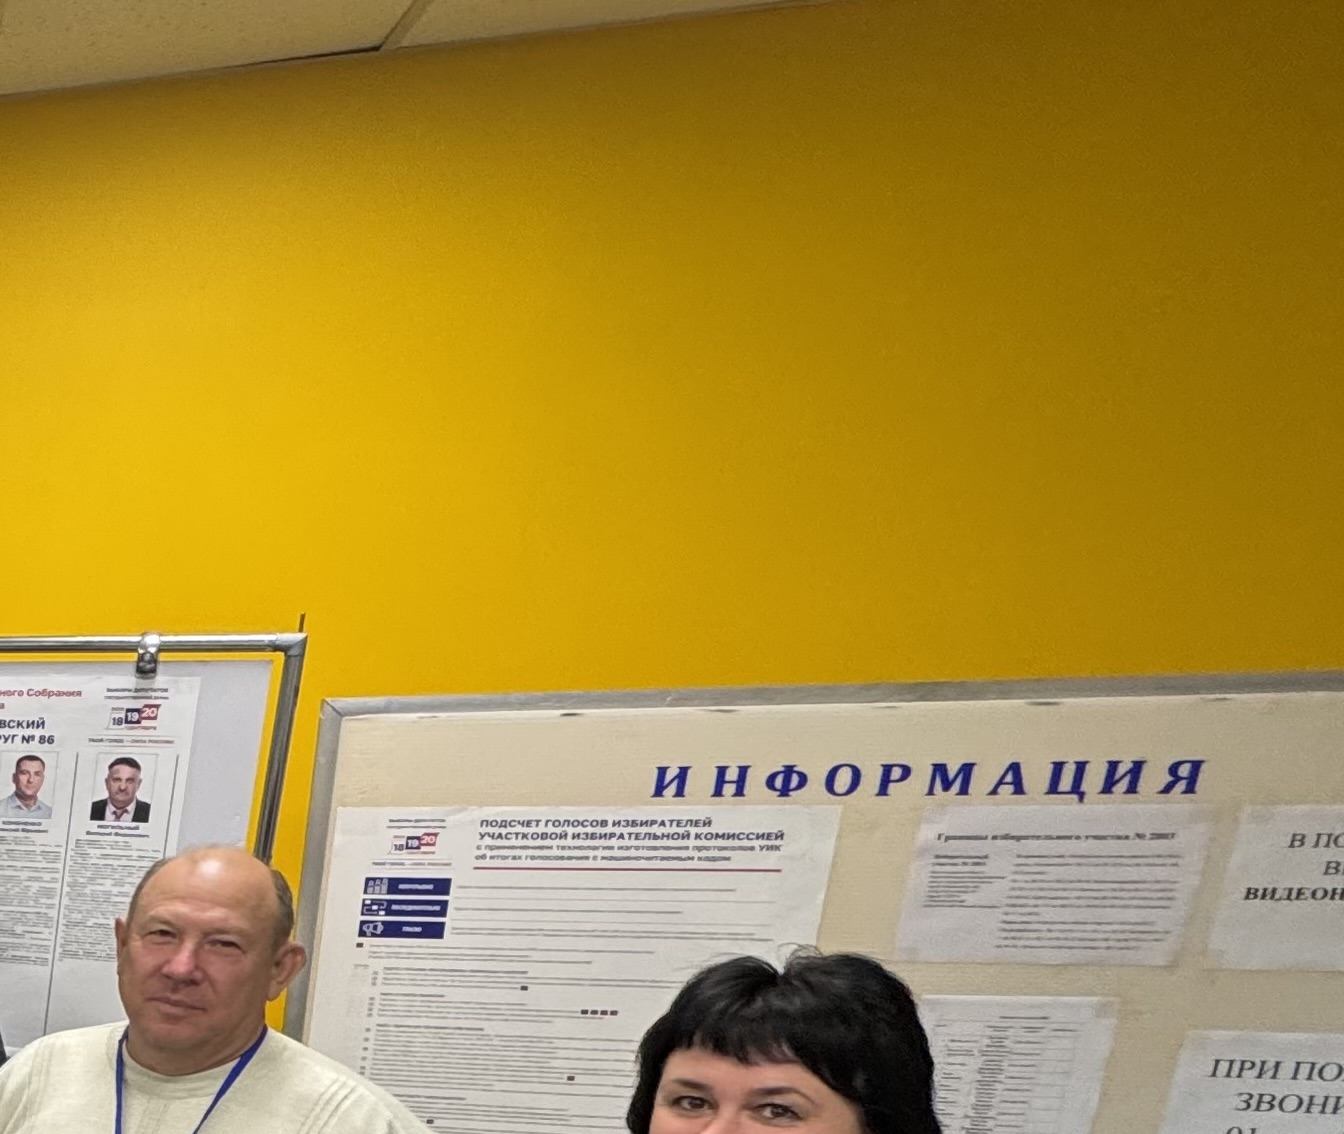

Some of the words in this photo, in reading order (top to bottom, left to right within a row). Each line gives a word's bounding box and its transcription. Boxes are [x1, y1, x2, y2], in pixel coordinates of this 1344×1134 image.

[26, 689, 82, 699] Собрания
[127, 711, 139, 721] 19
[141, 708, 157, 718] 20
[21, 734, 35, 744] №
[38, 735, 55, 744] 86
[650, 760, 1206, 803] ИНФОРМАЦИЯ
[480, 819, 542, 829] ПОДСЧЕТ
[544, 819, 609, 828] ГОЛОСОВ
[612, 816, 713, 828] ИЗБИРАТЕЛЕЙ
[407, 838, 419, 847] 19
[420, 833, 436, 843] 20
[478, 829, 568, 840] УЧАСТКОВОЙ
[571, 829, 691, 841] ИЗБИРАТЕЛЬНОЙ
[694, 829, 785, 841] КОМИССИЕЙ
[1288, 832, 1306, 848] В
[1208, 1058, 1282, 1080] ПРИ
[1290, 1061, 1344, 1082] ПО
